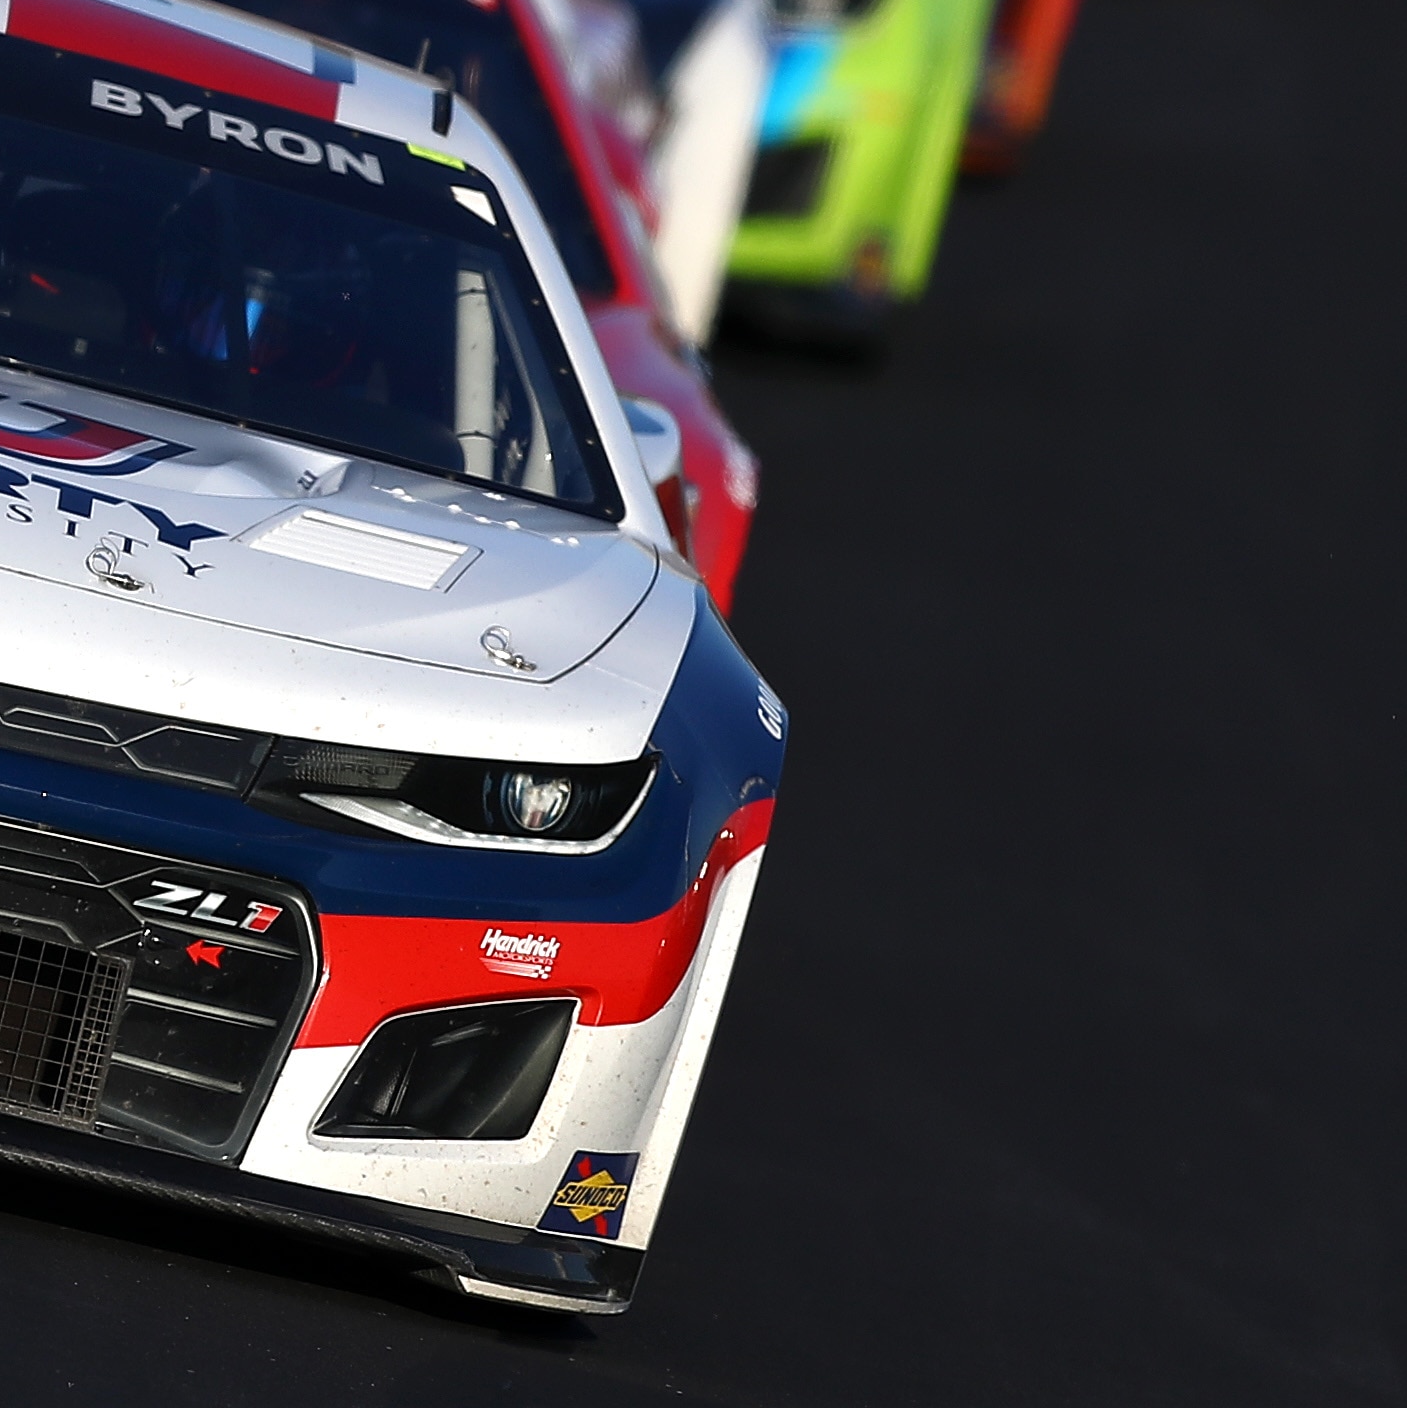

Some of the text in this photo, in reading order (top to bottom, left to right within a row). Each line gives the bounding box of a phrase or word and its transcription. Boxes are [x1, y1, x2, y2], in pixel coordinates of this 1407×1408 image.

[91, 78, 385, 186] BYRON
[133, 880, 284, 934] ZL1
[480, 928, 561, 959] Hendrick
[555, 1184, 626, 1208] SUNOCO
